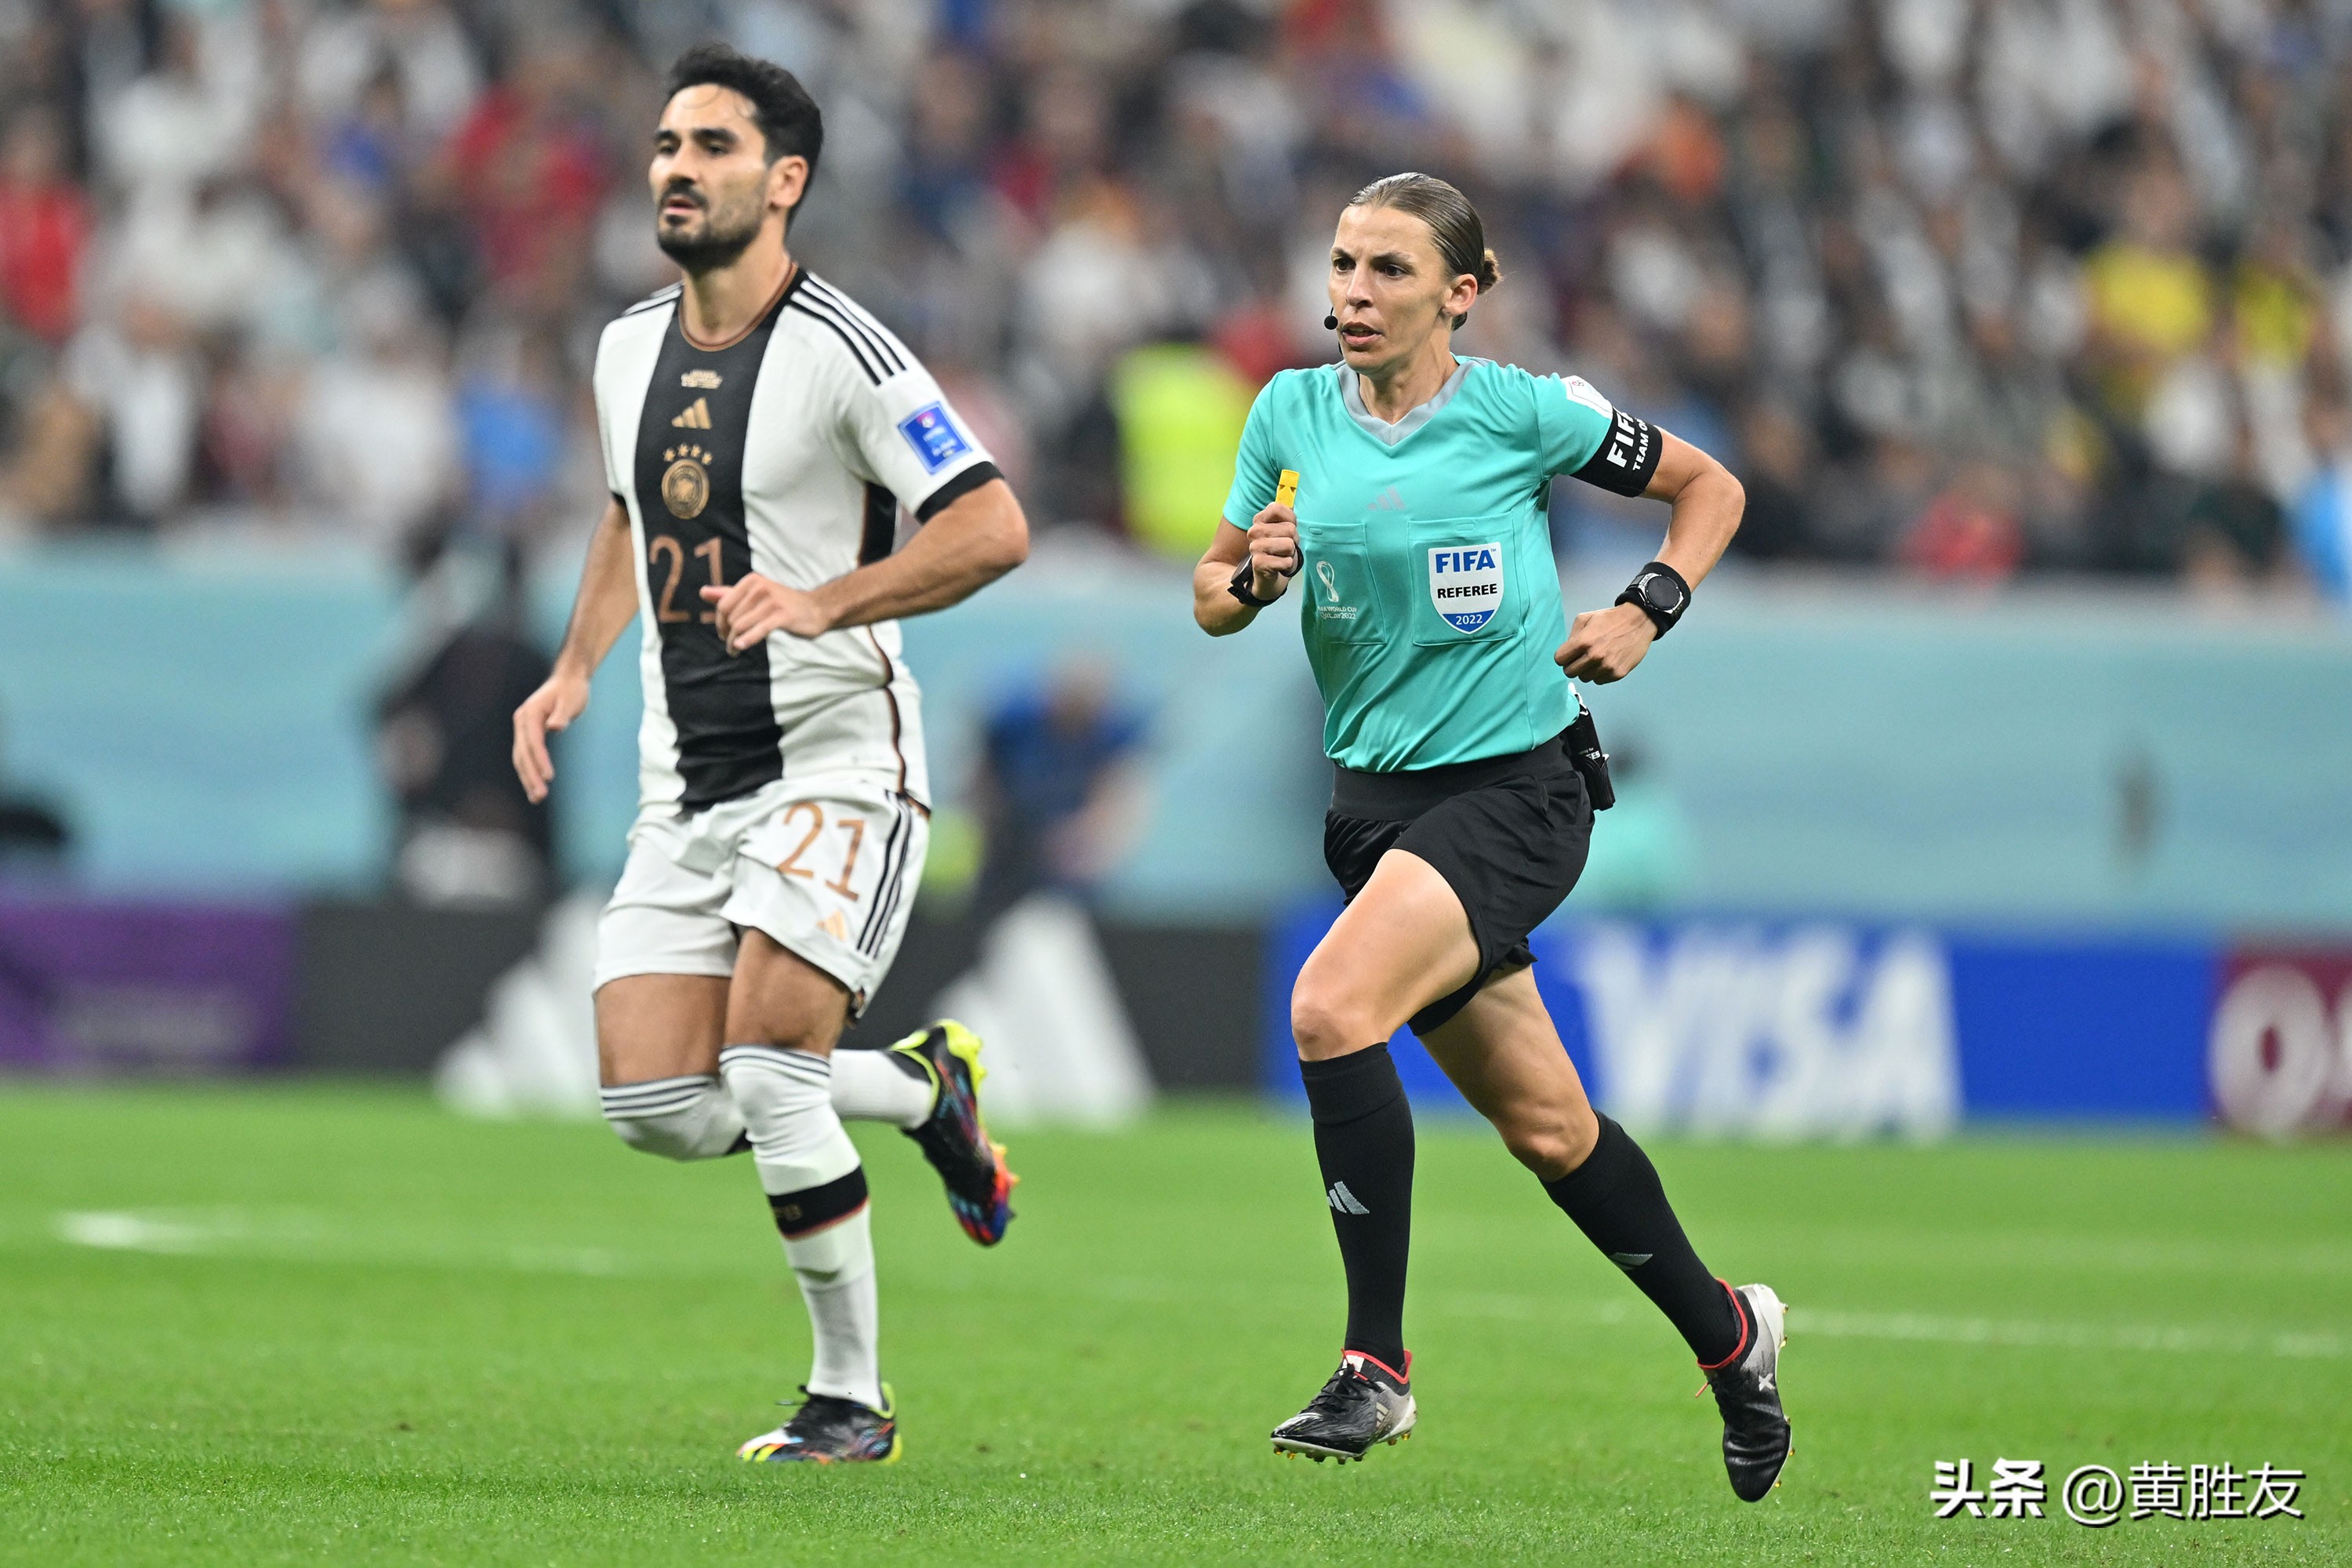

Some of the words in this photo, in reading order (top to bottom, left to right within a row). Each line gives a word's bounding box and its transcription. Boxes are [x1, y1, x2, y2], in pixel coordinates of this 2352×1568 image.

[1632, 432, 1649, 470] TEAM
[648, 535, 724, 624] 21
[1436, 550, 1496, 574] FIFA
[1437, 583, 1497, 599] REFEREE
[1455, 614, 1483, 626] 2022
[777, 801, 866, 902] 21
[1570, 927, 1962, 1138] VISA
